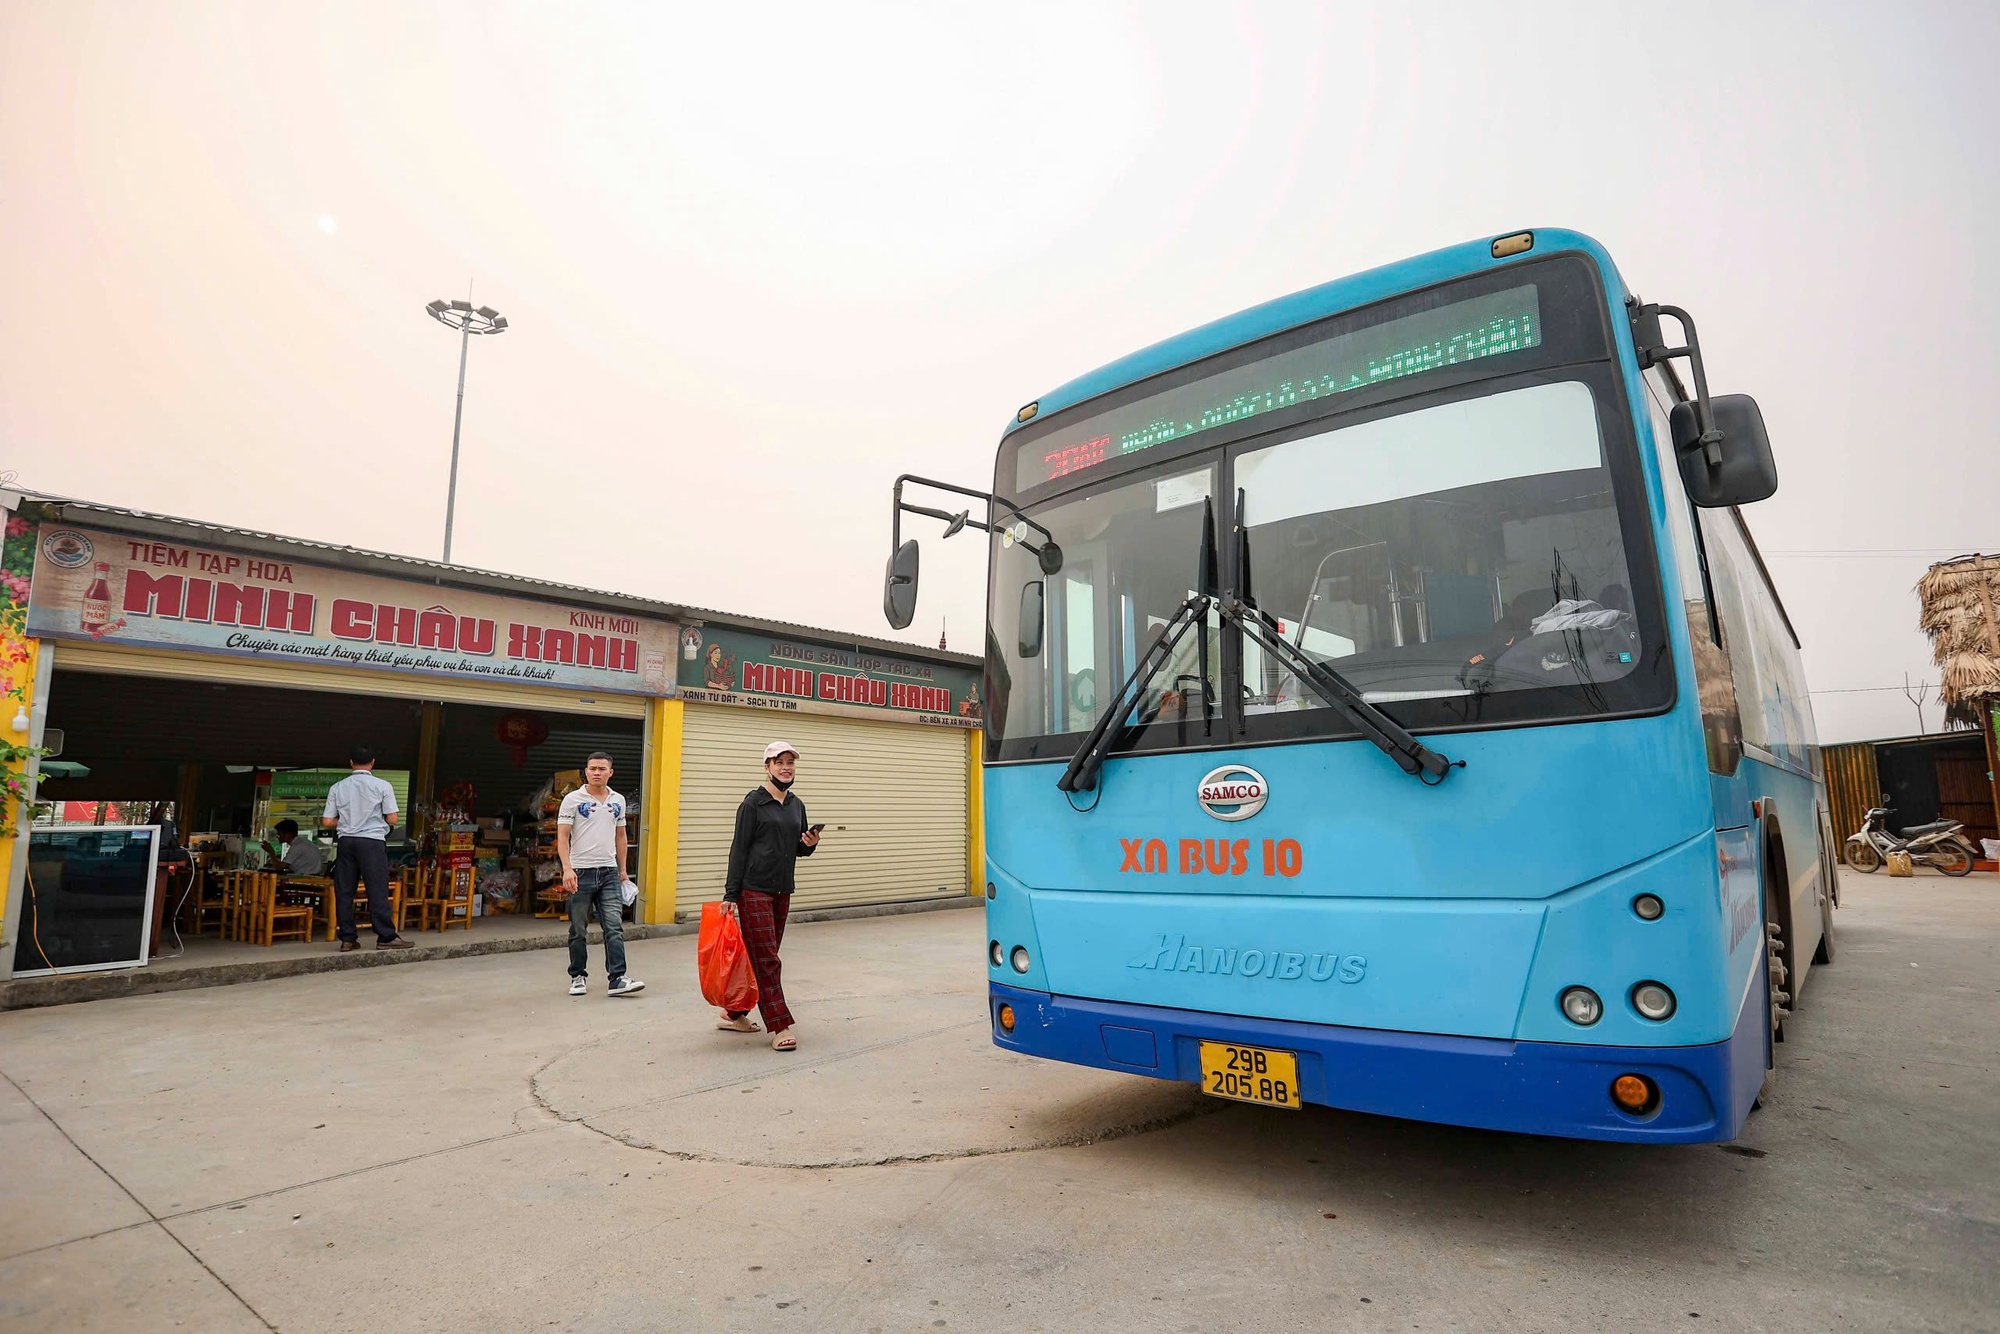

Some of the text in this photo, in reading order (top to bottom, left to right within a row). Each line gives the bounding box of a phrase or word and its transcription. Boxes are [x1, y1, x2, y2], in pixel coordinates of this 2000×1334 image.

[127, 540, 189, 568] TIỆM
[197, 551, 240, 576] TẠP
[123, 568, 315, 635] MINH
[330, 598, 495, 655] CHÂU
[507, 622, 638, 674] XANH
[226, 632, 279, 654] Chuyên
[280, 642, 302, 653] các
[302, 644, 331, 658] mặt
[331, 644, 362, 664] hàng
[365, 649, 394, 664] thiết
[391, 653, 414, 667] yếu
[413, 655, 442, 670] phục
[443, 661, 457, 672] vụ
[457, 659, 473, 672] bà
[474, 665, 491, 674] con
[492, 664, 506, 675] và
[507, 664, 521, 676] du
[771, 644, 814, 661] NÔNG
[820, 650, 849, 667] SẢN
[916, 666, 933, 678] XÃ
[682, 690, 706, 700] XANH
[709, 690, 719, 701] TỪ
[721, 692, 737, 703] ĐẤT
[747, 697, 767, 707] SẠCH
[742, 661, 950, 713] MINH CHÂU XANH
[1202, 784, 1261, 800] SAMCO
[1178, 838, 1249, 876] BUS
[1262, 838, 1303, 878] 10
[1127, 933, 1368, 984] HANOIBUS
[1226, 1047, 1267, 1073] 29B
[1212, 1071, 1287, 1104] 205.88
